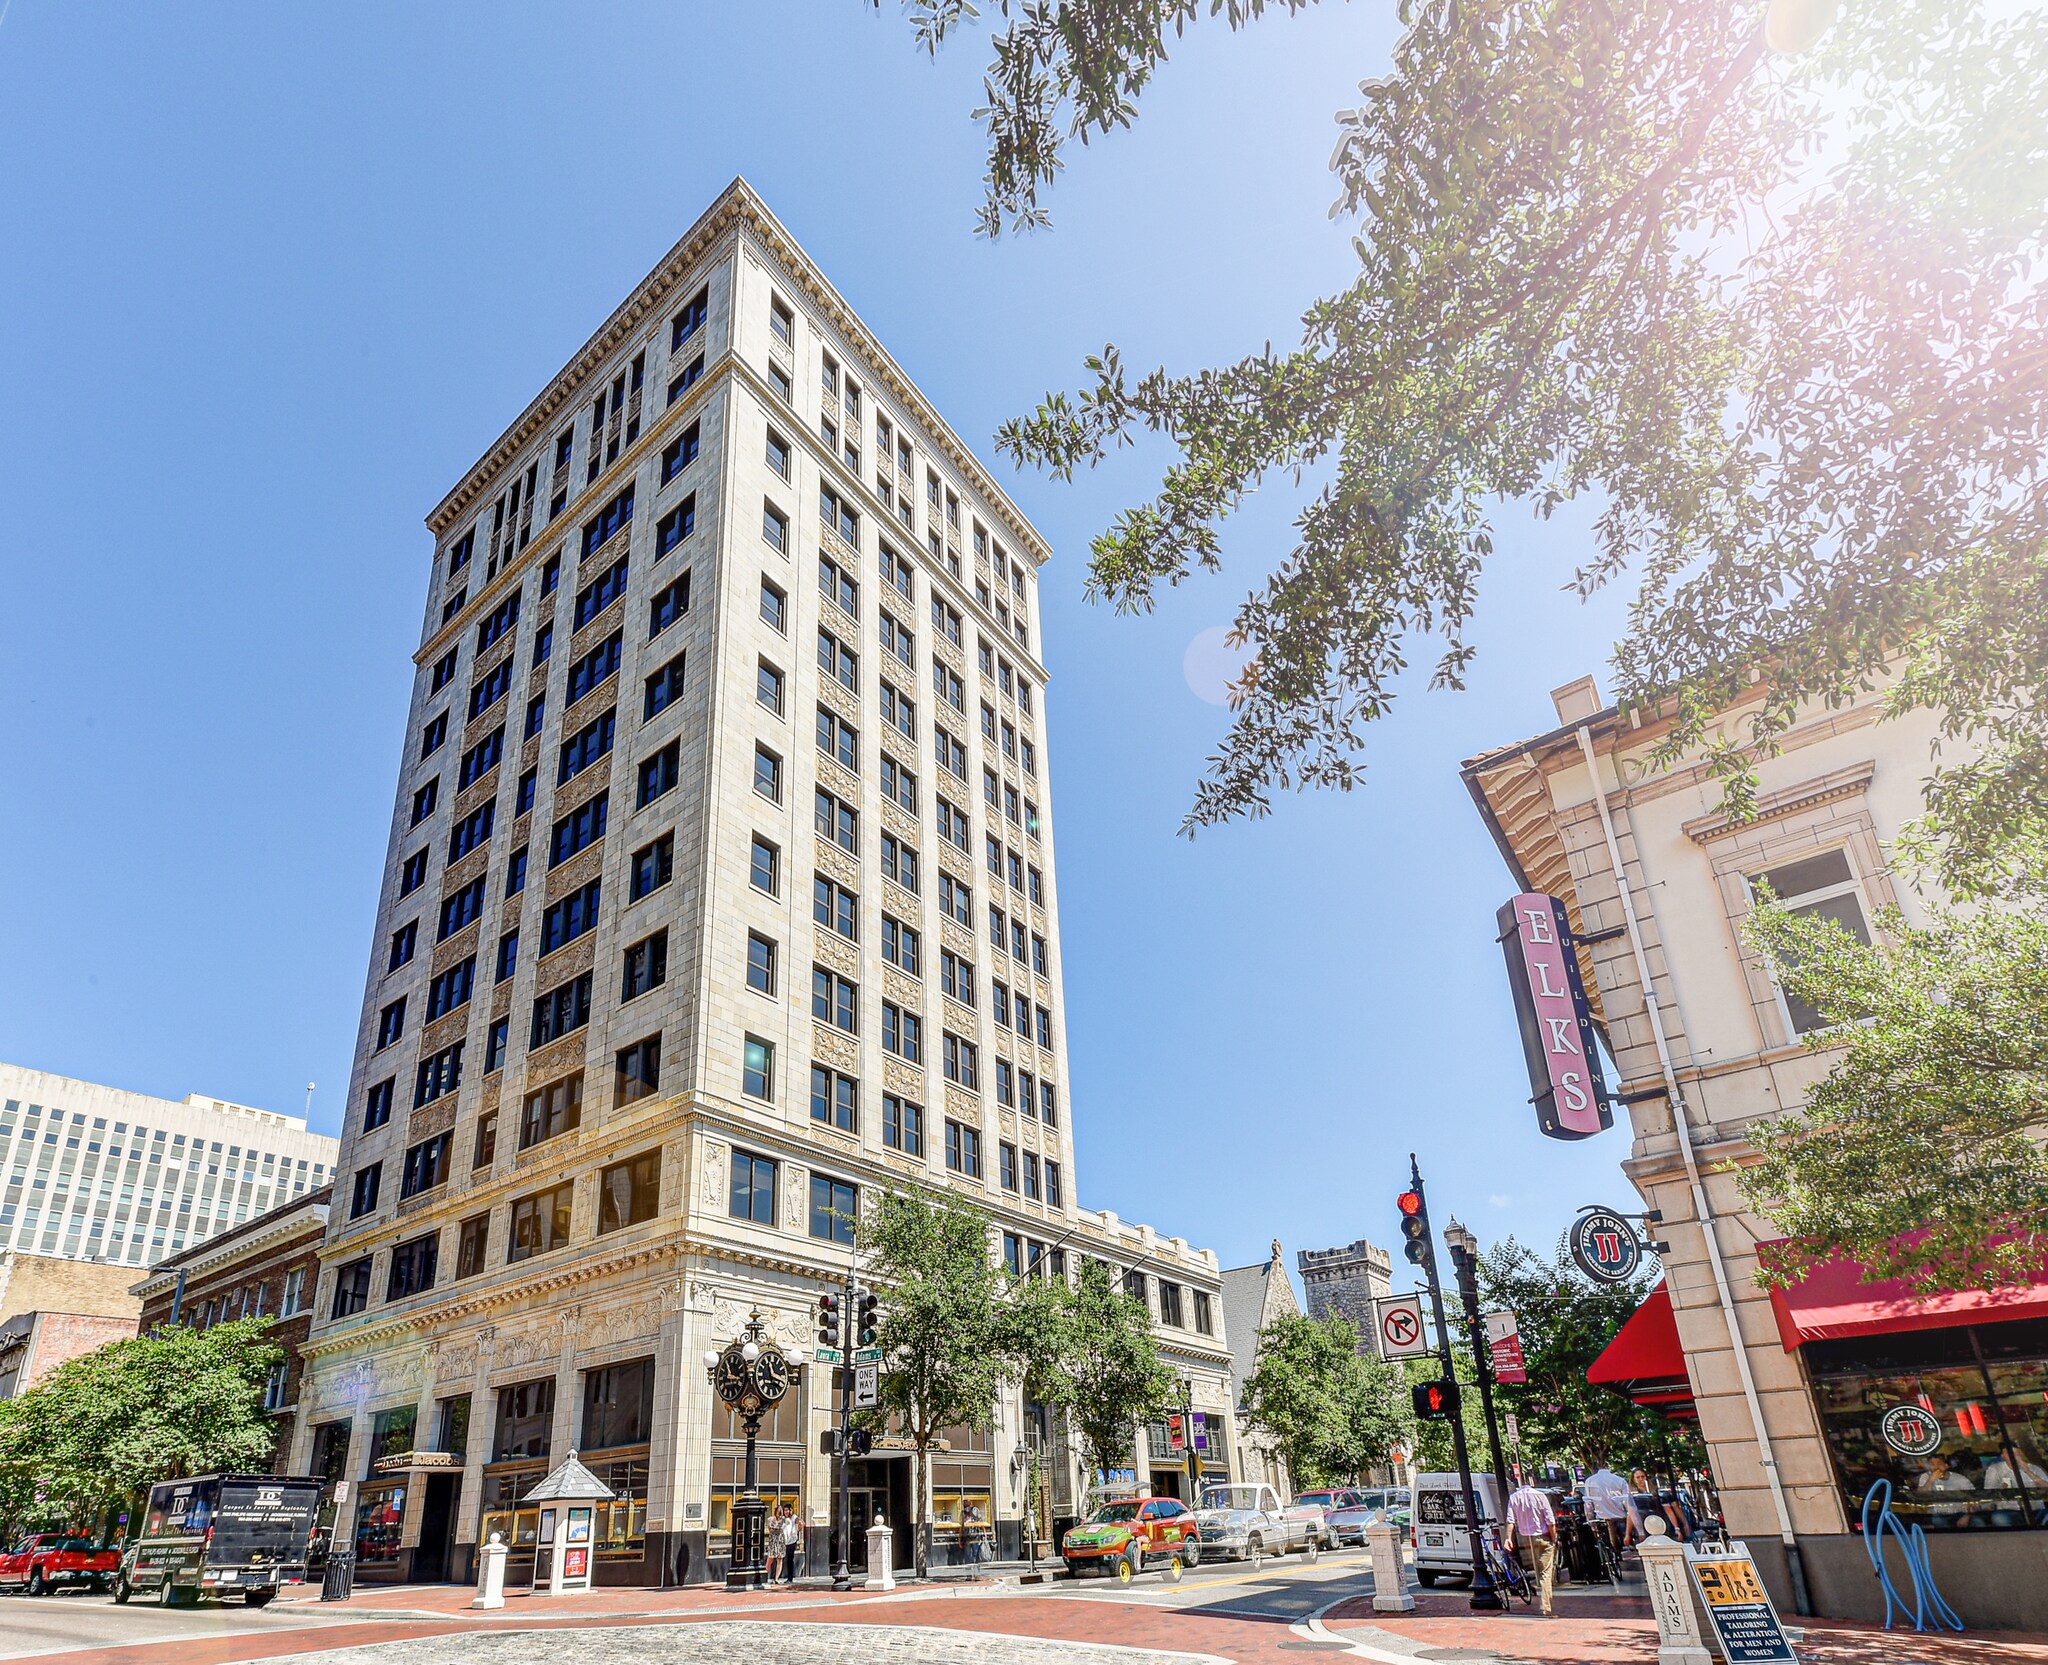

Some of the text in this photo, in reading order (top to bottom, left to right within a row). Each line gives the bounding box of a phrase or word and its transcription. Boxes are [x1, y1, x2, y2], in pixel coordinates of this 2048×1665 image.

[1523, 909, 1588, 1112] ELKS
[1557, 911, 1609, 1113] BUILDING
[1583, 1219, 1632, 1248] JIMMY JOHN'S
[1593, 1233, 1621, 1263] JJ
[1586, 1252, 1610, 1274] GOURMET
[817, 1349, 830, 1361] Laura
[856, 1352, 872, 1361] Adams
[859, 1369, 873, 1380] ONE
[859, 1379, 874, 1390] WAY
[1886, 1410, 1936, 1432] JIMMY JOHN'S
[1897, 1420, 1925, 1442] JJ
[420, 1455, 460, 1466] Jacobs
[1662, 1571, 1681, 1628] ADAMS
[1716, 1611, 1770, 1621] PROFESSIONAL
[1725, 1620, 1768, 1630] TAILORING
[1733, 1629, 1780, 1639] ALTERATION
[1728, 1638, 1782, 1648] FOR MEN AND
[1744, 1648, 1775, 1657] WOMEN
